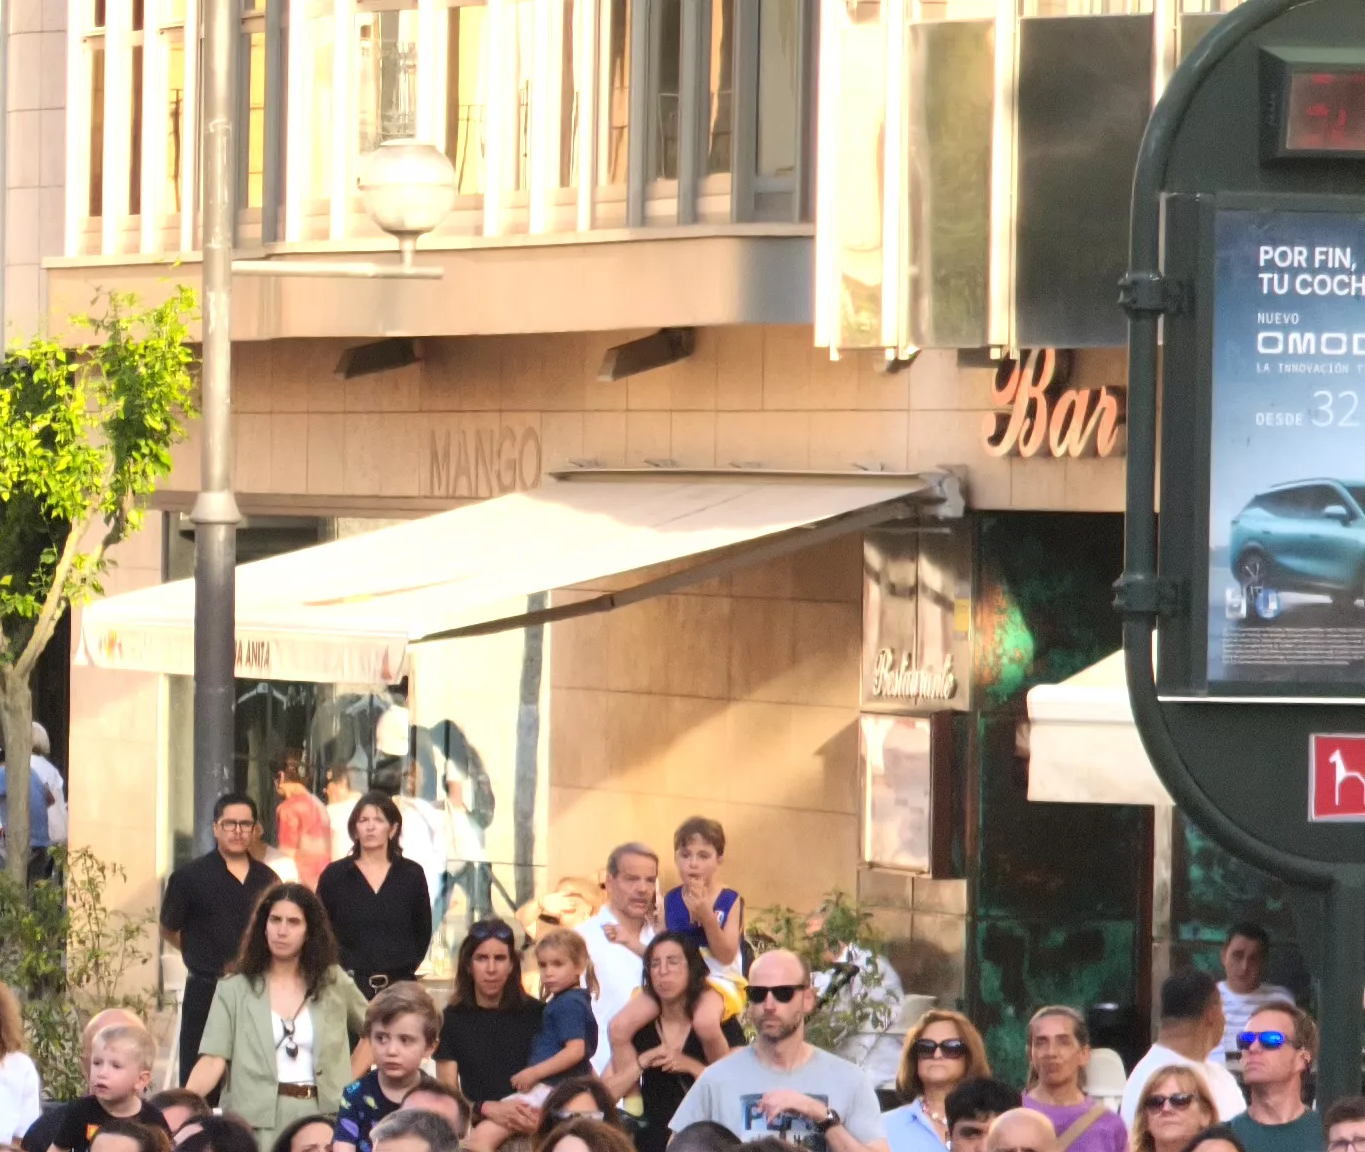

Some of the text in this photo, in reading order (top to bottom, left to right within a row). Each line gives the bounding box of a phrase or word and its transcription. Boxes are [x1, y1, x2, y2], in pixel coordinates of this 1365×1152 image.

[1259, 246, 1357, 272] POR FIN,
[1258, 273, 1289, 295] TU
[1257, 312, 1300, 324] NUEVO
[1256, 362, 1270, 374] LA
[982, 347, 1118, 457] Bar
[1255, 390, 1361, 427] DESDE 32
[430, 426, 542, 497] MANGO
[245, 639, 270, 669] ANITA
